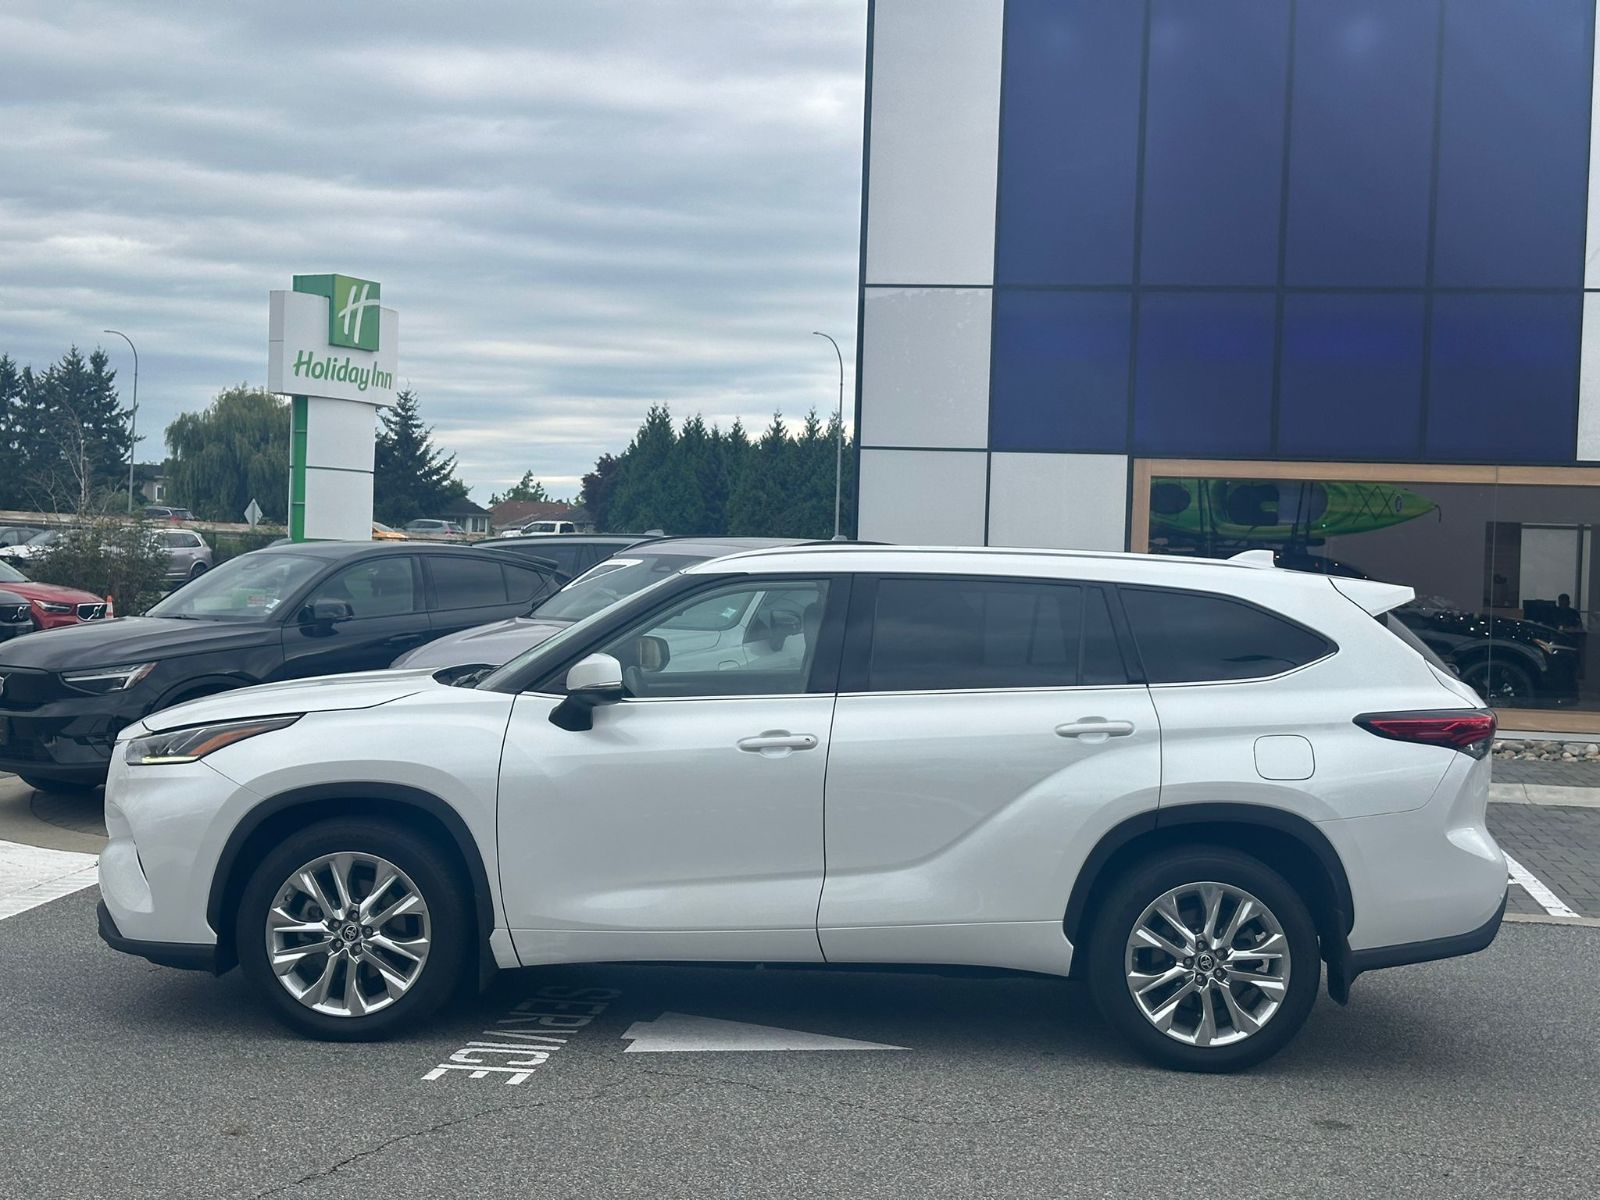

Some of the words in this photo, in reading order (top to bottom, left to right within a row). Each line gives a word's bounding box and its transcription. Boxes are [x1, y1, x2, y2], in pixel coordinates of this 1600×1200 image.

[293, 350, 370, 391] Holiday
[371, 361, 393, 390] Inn
[421, 986, 622, 1085] SERVICE
